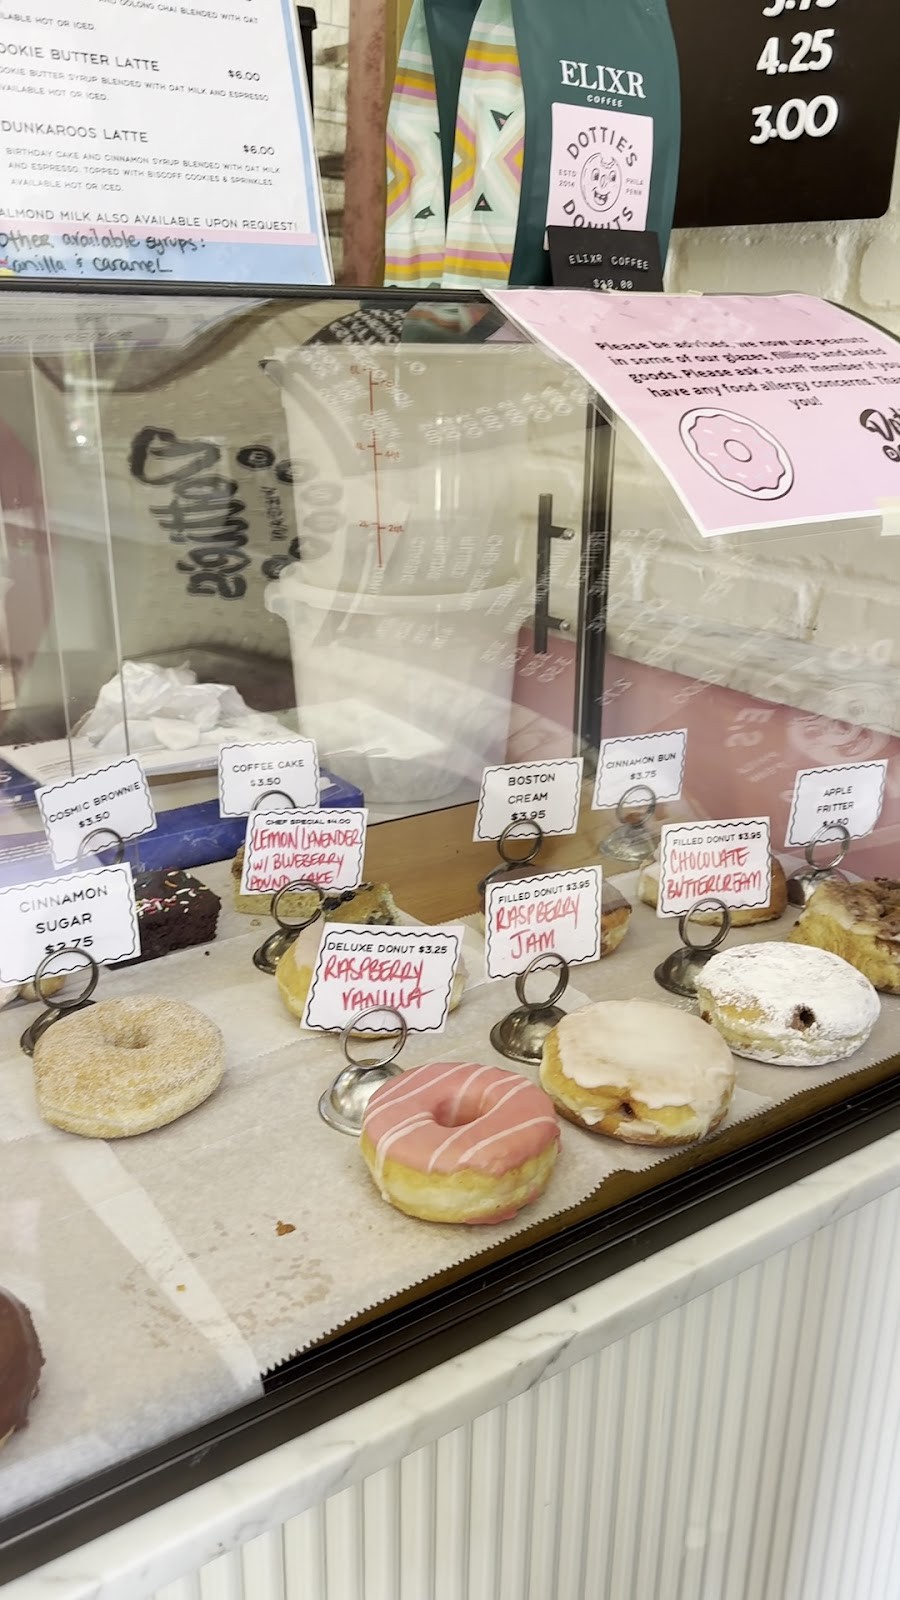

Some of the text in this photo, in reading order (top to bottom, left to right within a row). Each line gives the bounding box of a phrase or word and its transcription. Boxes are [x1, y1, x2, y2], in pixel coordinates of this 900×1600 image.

[220, 12, 240, 22] WITH
[756, 28, 835, 76] 4.25
[51, 48, 110, 66] BUTTER
[115, 56, 160, 72] LATTE
[228, 69, 260, 81] $6.00
[559, 59, 647, 99] ELIXR
[144, 81, 166, 91] WITH
[188, 86, 207, 96] MILK
[209, 89, 226, 98] AND
[586, 94, 624, 108] COFFEE
[749, 94, 839, 145] 3.00
[1, 119, 276, 156] DUNKAROOS LATTE $6.00
[566, 126, 638, 168] DOTTIE'S
[83, 153, 101, 161] AND
[223, 160, 242, 171] WITH
[0, 207, 54, 220] ALMOND
[60, 210, 91, 223] MILK
[96, 212, 129, 224] ALSO
[134, 214, 200, 227] AVAILABLE
[205, 217, 238, 229] UPON
[62, 228, 141, 249] available
[145, 235, 206, 256] syrups:
[568, 253, 649, 270] ELIXR COFFEE
[594, 341, 650, 351] Please
[648, 340, 672, 349] be
[760, 339, 788, 347] now
[789, 338, 816, 346] use
[816, 336, 868, 347] peanuts
[607, 347, 887, 366] in some of our glazes, fillings and baked
[628, 369, 683, 384] goods.
[681, 367, 733, 379] Please
[734, 366, 762, 376] ask
[762, 367, 774, 375] a
[774, 364, 808, 374] staff
[809, 363, 864, 373] member
[862, 360, 877, 370] if
[646, 387, 691, 398] have
[692, 385, 723, 397] any
[721, 382, 759, 393] food
[760, 379, 811, 392] allergy
[811, 377, 876, 389] concerns.
[787, 395, 823, 410] you!
[231, 759, 306, 774] COFFEE CAKE
[605, 752, 677, 770] CINNAMON BUN
[249, 776, 282, 788] $3.50
[507, 773, 556, 787] BOSTON
[629, 769, 658, 781] $3.75
[48, 780, 142, 823] COSMIC BROWNIE
[507, 791, 549, 805] CREAM
[822, 785, 853, 798] APPLE
[510, 809, 547, 821] $395
[815, 801, 855, 814] FRITTER
[77, 810, 111, 829] $3.50
[822, 817, 849, 828] $50
[252, 825, 363, 852] LEMON LAVENDER
[672, 830, 762, 847] FILLED DONUT $3.95
[670, 845, 751, 875] CHOCOLATE
[498, 879, 591, 904] FILLED DONUT $3.95
[666, 869, 763, 900] BUTTERCREAM
[20, 885, 109, 913] CINNAMON
[495, 893, 581, 933] RASPBERRY
[35, 912, 93, 935] SUGAR
[44, 935, 94, 956] $275
[327, 941, 448, 955] DELUXE DONUT $3.25
[509, 928, 556, 960] JAM
[323, 954, 424, 990] RASPBERRY
